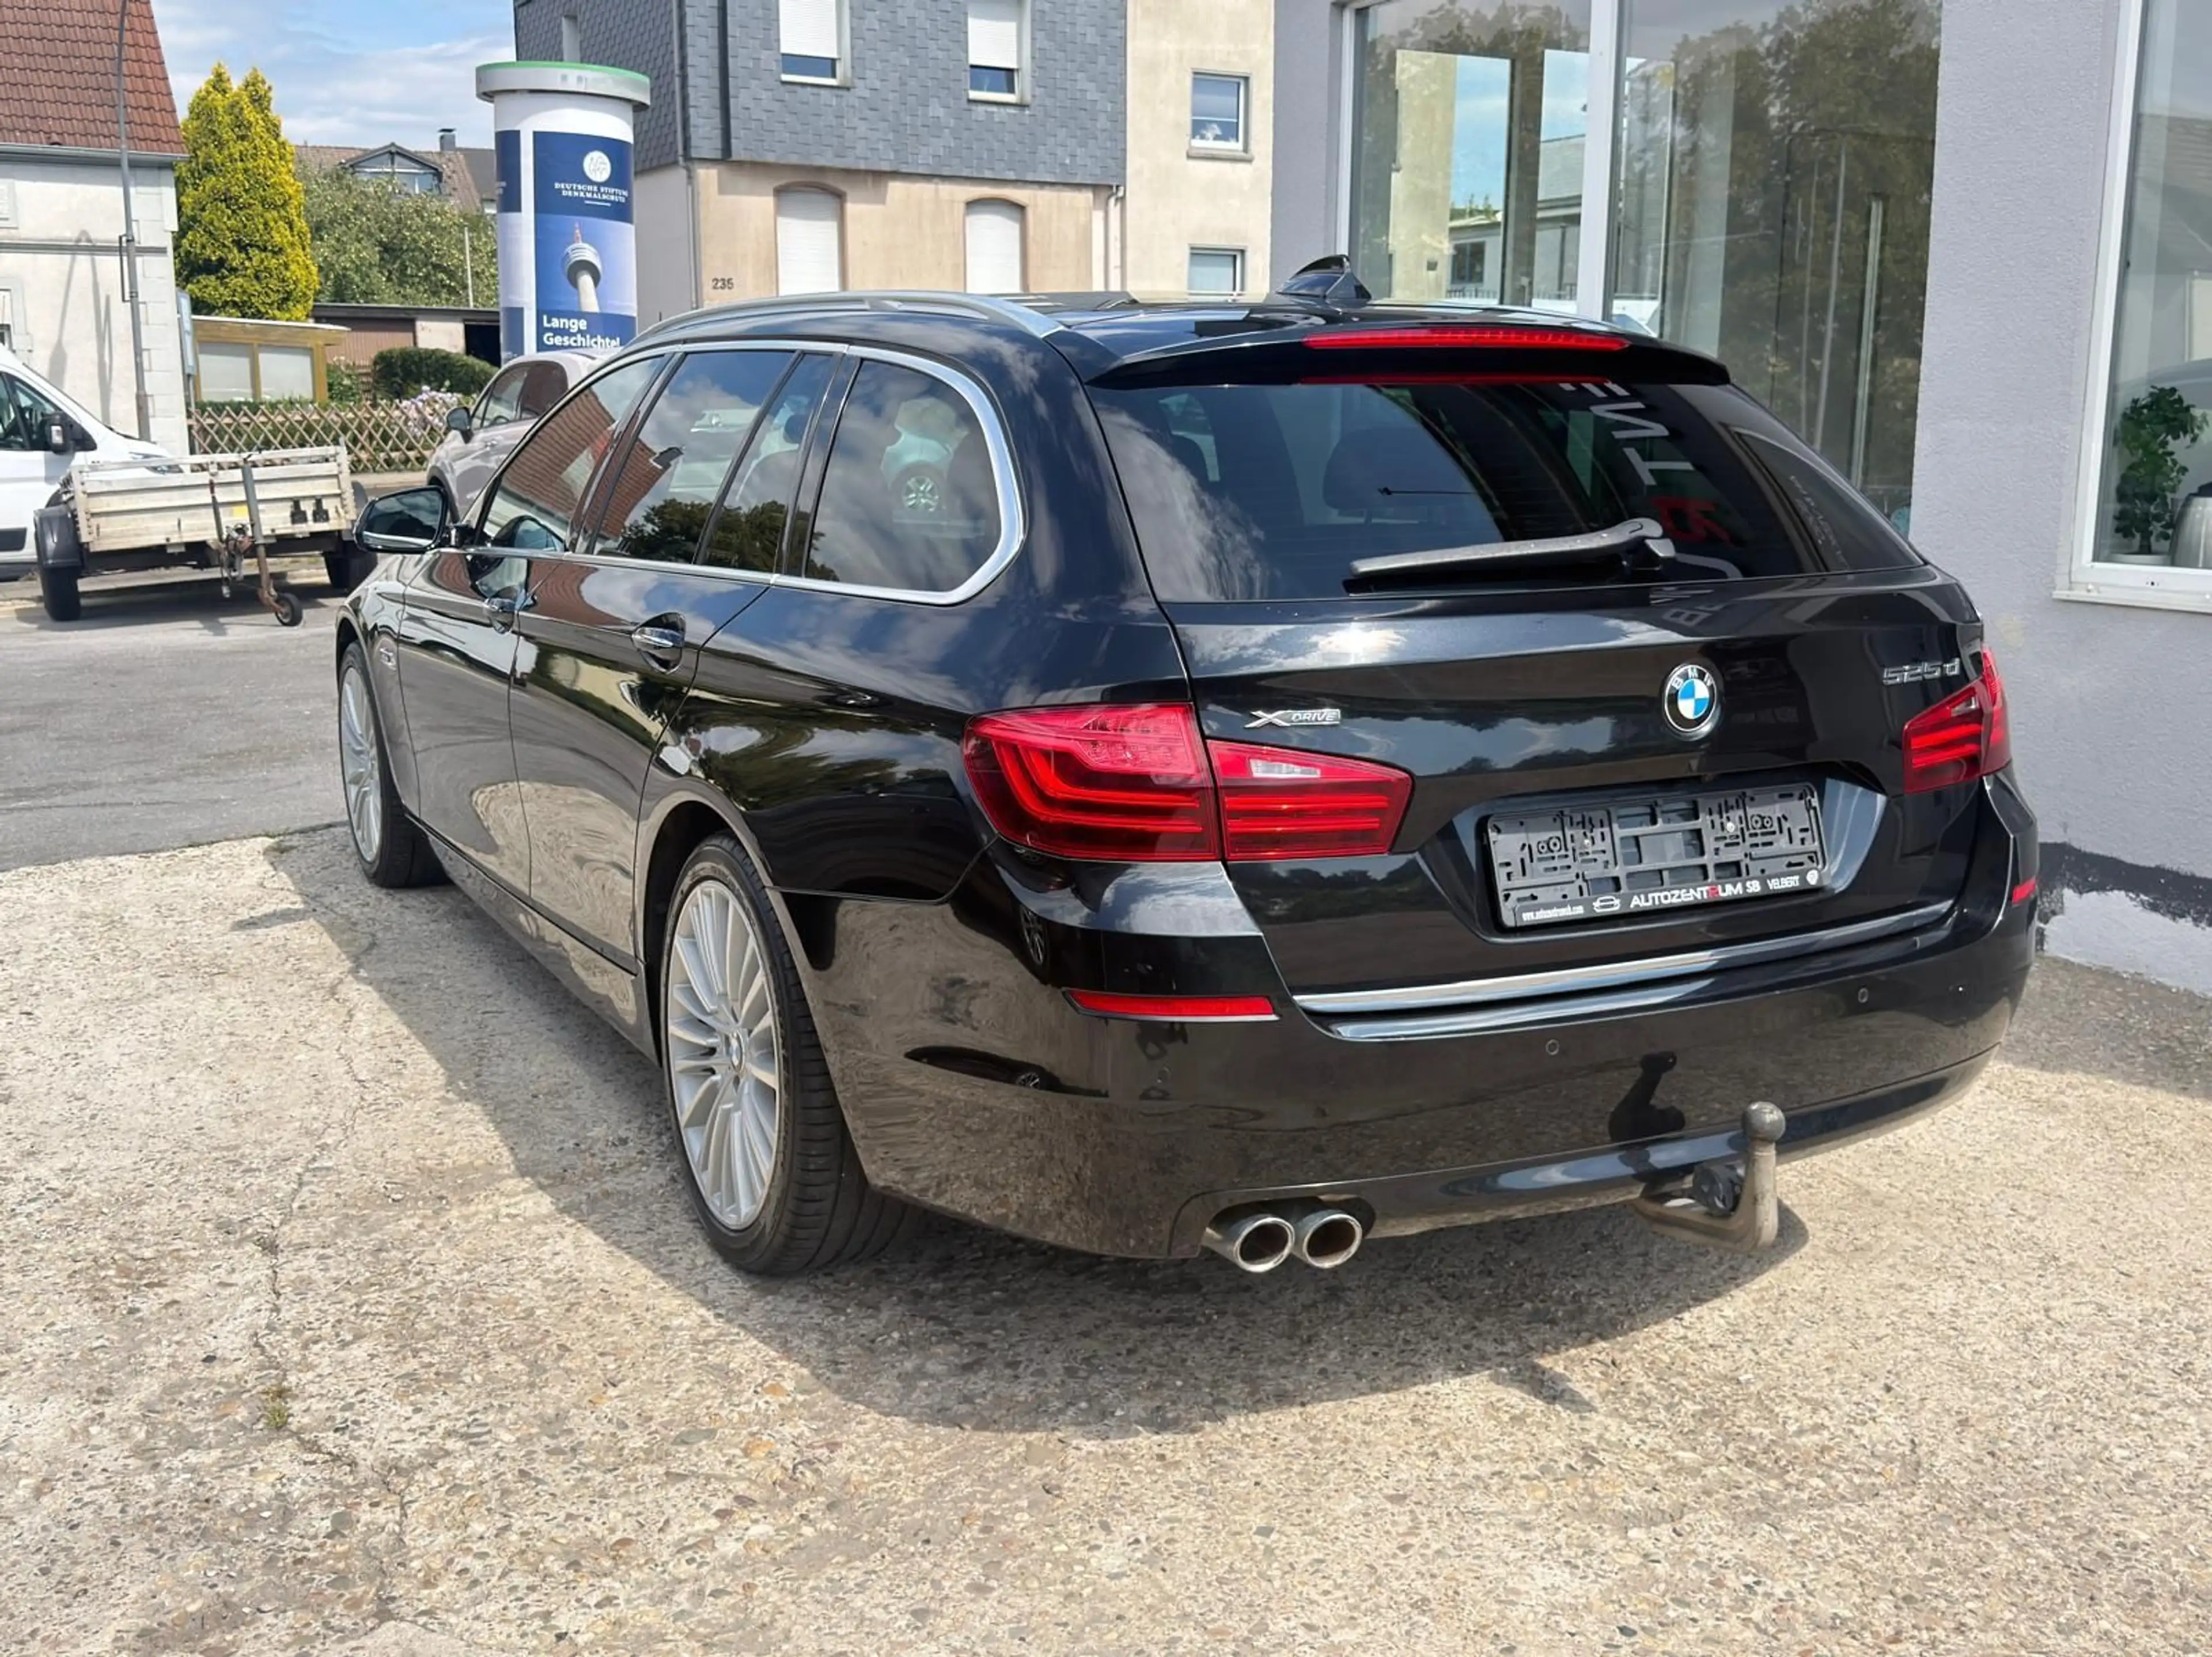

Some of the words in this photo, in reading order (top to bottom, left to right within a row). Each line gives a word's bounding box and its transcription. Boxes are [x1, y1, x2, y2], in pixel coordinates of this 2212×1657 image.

[554, 182, 598, 192] DEUTSCHE
[711, 278, 734, 290] 235
[543, 315, 587, 332] Lange
[1883, 658, 1960, 685] 525d
[1630, 882, 1743, 908] AUTOZENTRUM
